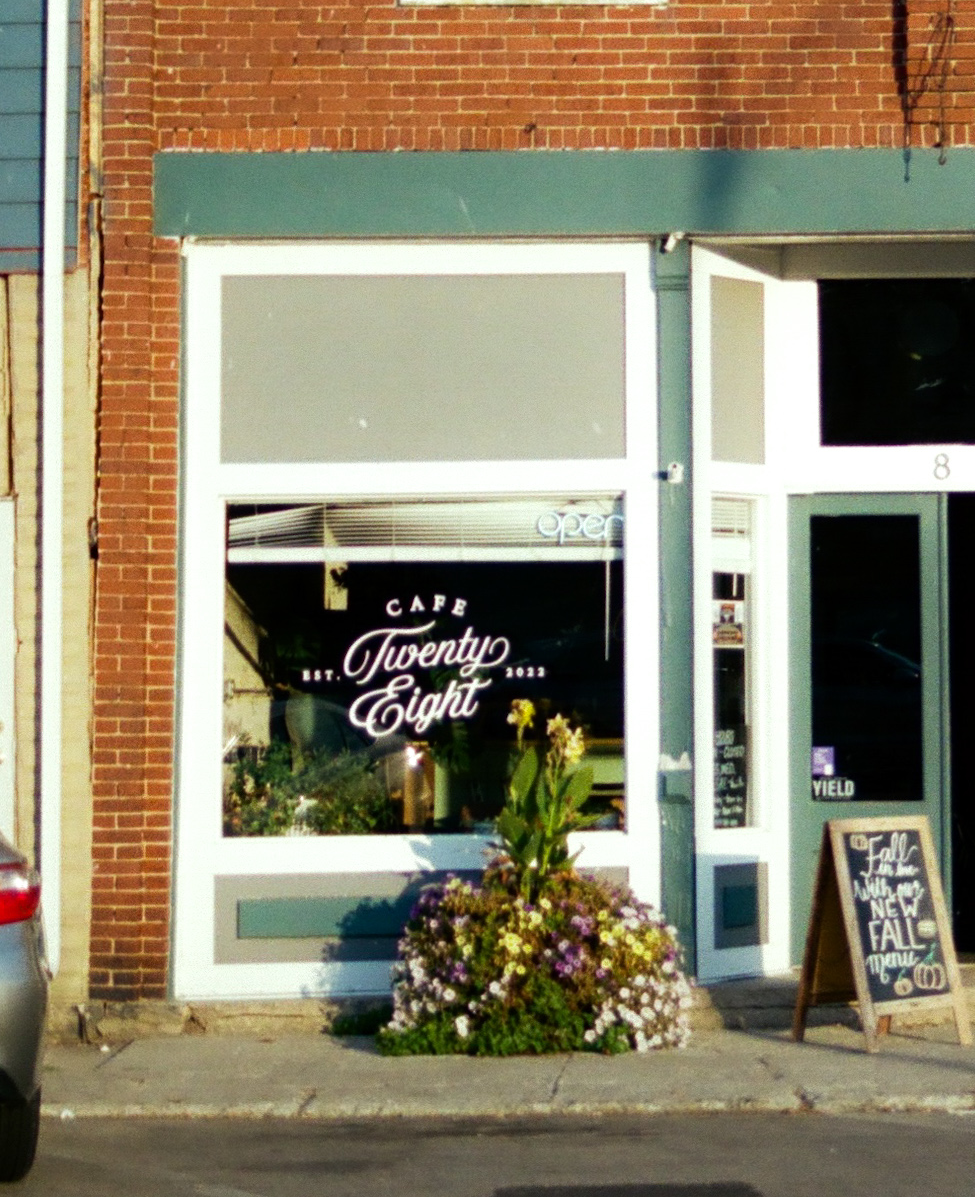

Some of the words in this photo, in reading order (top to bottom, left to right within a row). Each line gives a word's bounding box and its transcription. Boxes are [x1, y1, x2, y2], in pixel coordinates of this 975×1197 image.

[934, 453, 951, 481] 8
[386, 594, 467, 617] CAFE
[344, 620, 511, 685] Twenty
[302, 669, 341, 682] EST.
[505, 666, 546, 679] 2022
[349, 674, 492, 738] Eight
[812, 779, 855, 797] YIELD
[860, 831, 918, 878] Fall
[870, 897, 920, 920] NEW
[868, 918, 926, 952] FALL
[865, 951, 920, 985] menu
